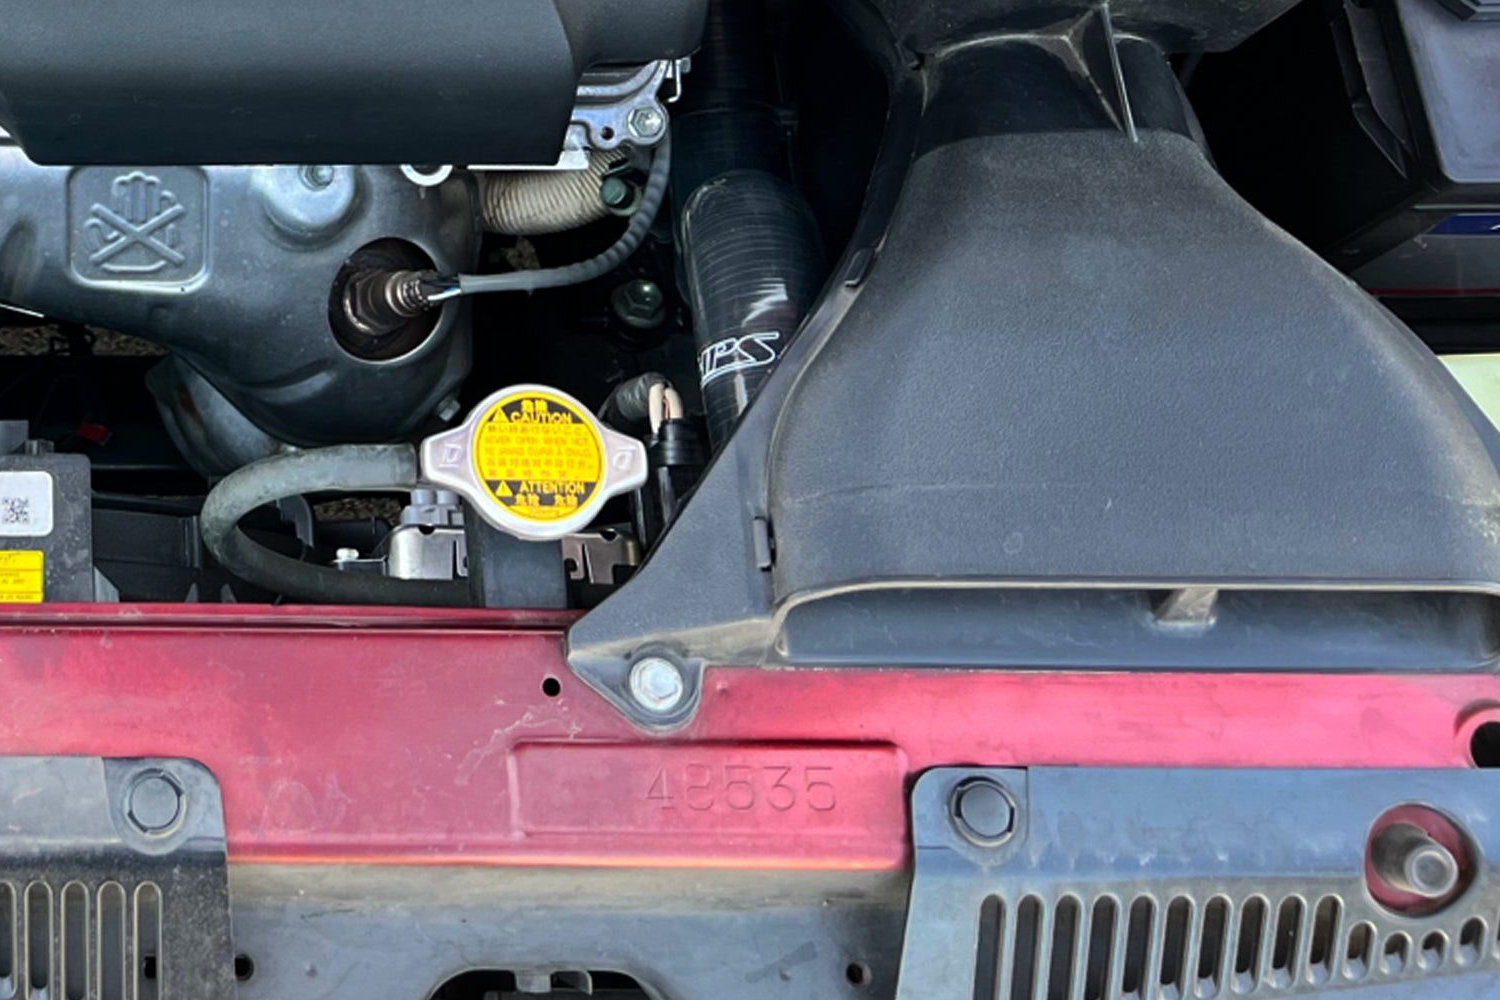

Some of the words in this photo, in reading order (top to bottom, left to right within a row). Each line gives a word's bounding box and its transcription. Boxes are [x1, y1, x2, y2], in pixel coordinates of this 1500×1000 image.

[510, 411, 572, 424] CAUTION
[519, 480, 586, 495] ATTENTION
[645, 763, 837, 812] 48535
